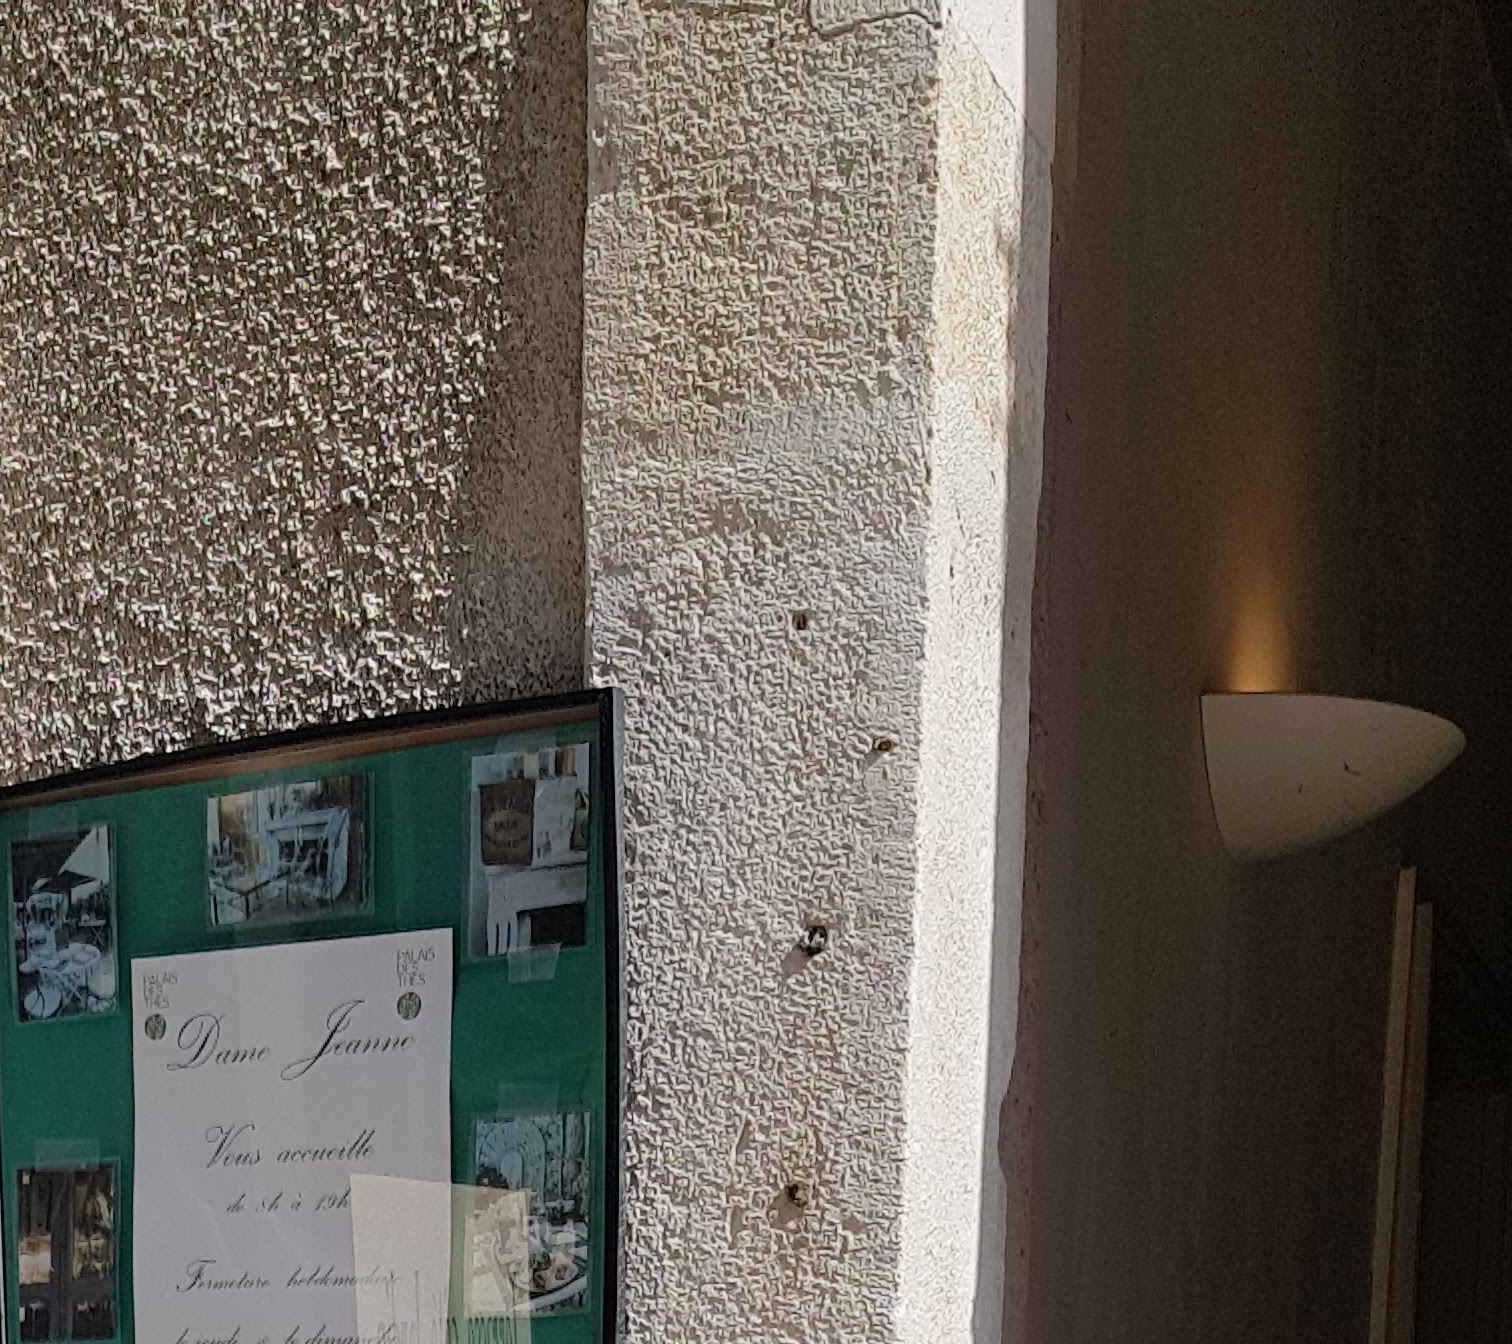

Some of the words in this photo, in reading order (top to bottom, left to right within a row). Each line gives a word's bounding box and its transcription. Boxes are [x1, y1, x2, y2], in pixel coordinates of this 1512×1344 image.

[166, 1013, 270, 1071] Dame
[280, 999, 415, 1081] Jeanne
[205, 1123, 261, 1169] Vous
[276, 1129, 376, 1164] accueille
[226, 1193, 246, 1213] de
[176, 1259, 270, 1294] Fermeture
